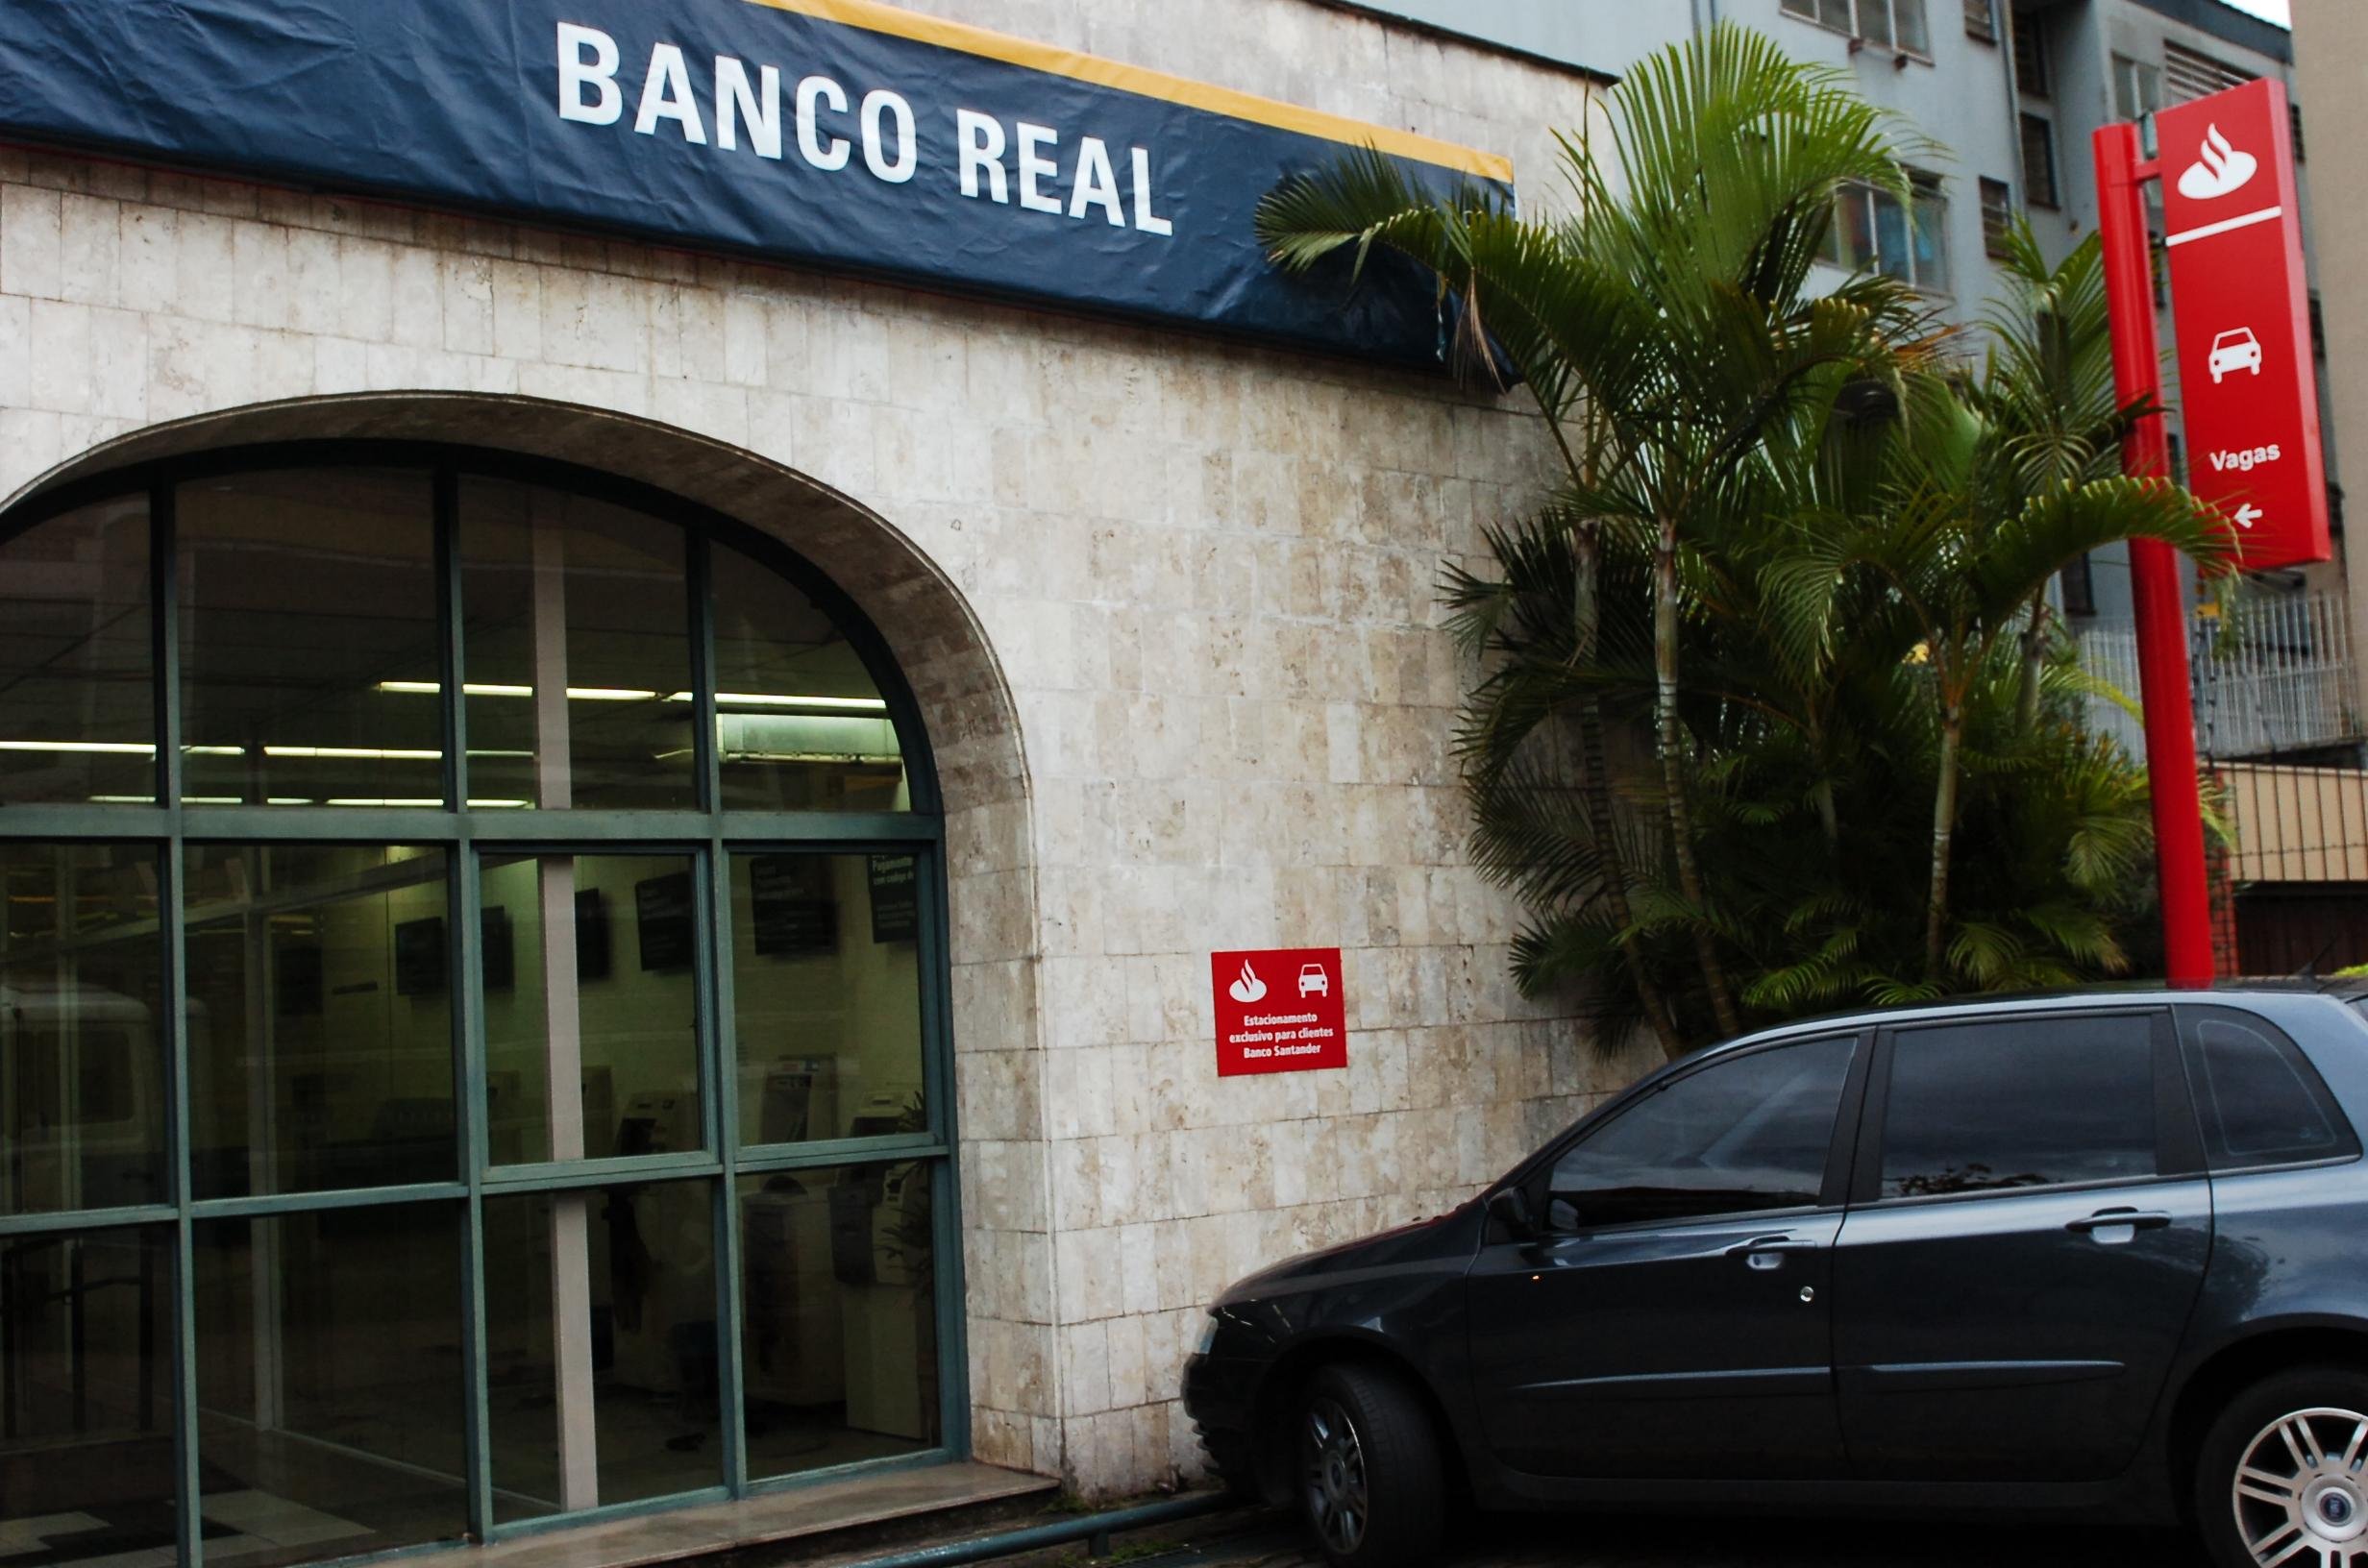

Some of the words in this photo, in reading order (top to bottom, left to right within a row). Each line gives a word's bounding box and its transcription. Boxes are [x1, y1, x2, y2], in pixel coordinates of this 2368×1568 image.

[556, 21, 917, 184] BANCO
[955, 108, 1172, 236] REAL
[2209, 444, 2281, 471] Vagas
[1244, 1013, 1318, 1026] Estacionamento
[1229, 1030, 1273, 1043] exclusivo
[1274, 1031, 1296, 1043] para
[1297, 1027, 1334, 1039] clientes
[1244, 1047, 1271, 1059] Banco
[1273, 1043, 1321, 1056] Santander
